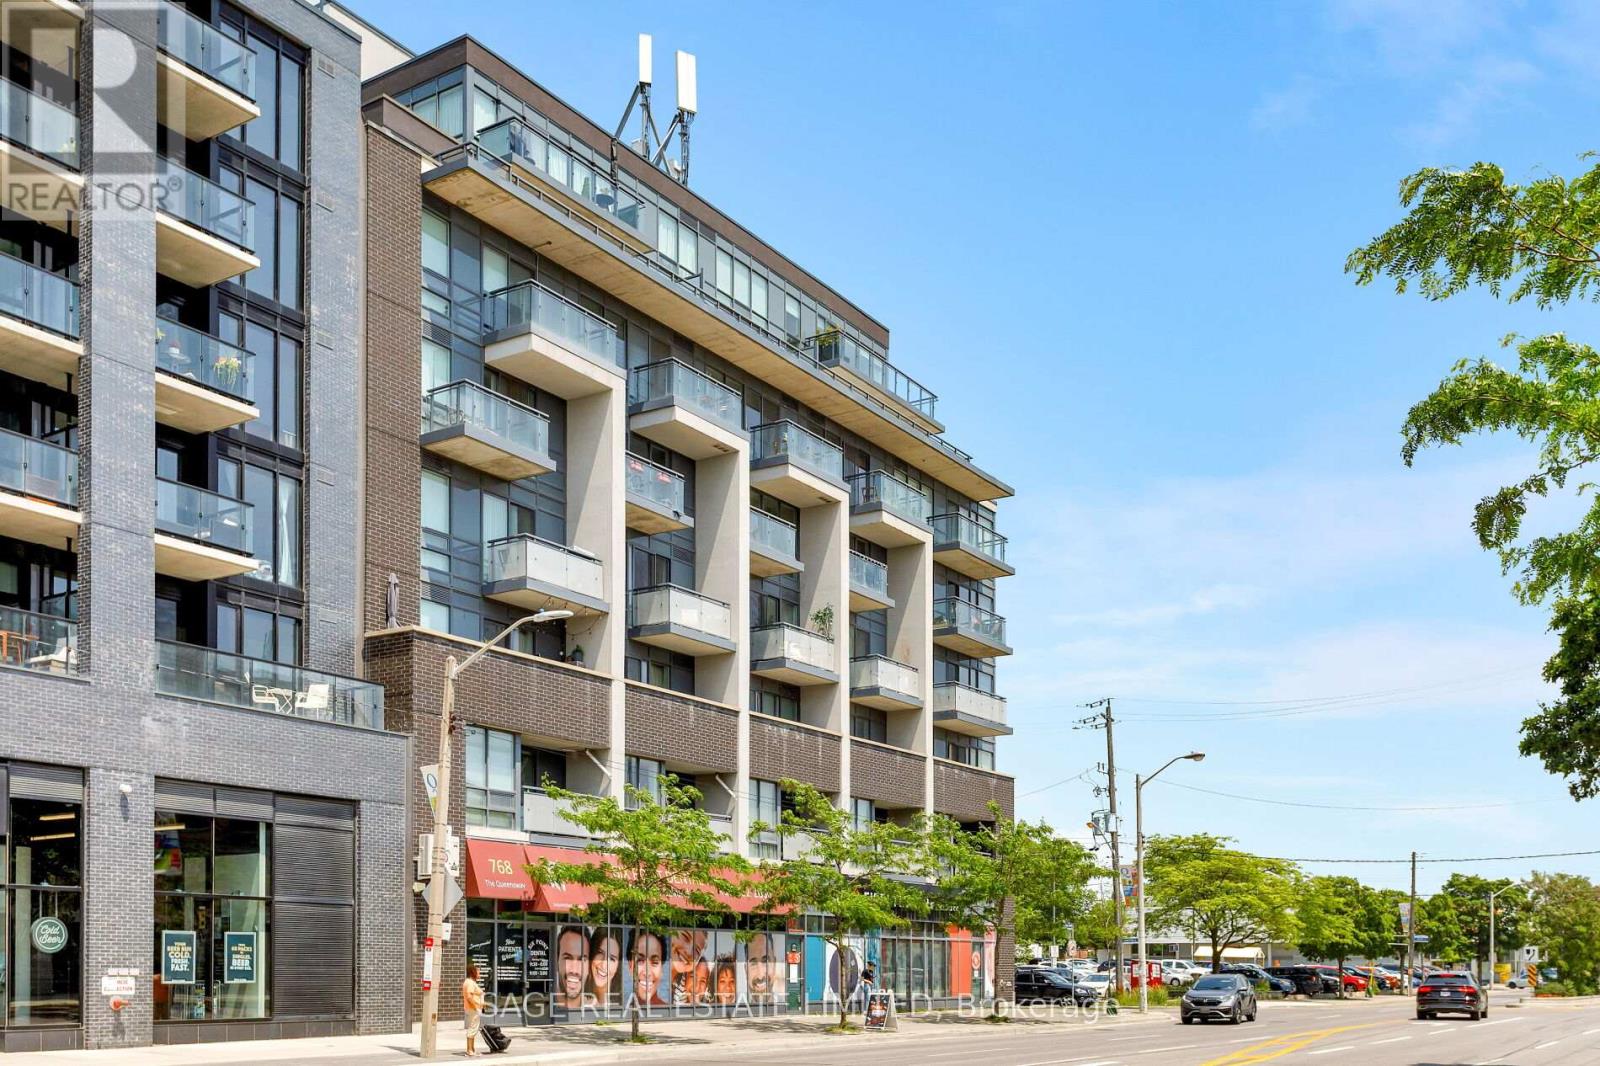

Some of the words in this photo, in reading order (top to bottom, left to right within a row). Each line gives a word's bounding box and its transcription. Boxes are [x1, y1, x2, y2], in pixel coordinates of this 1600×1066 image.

[488, 858, 513, 875] 768
[485, 879, 495, 888] The
[496, 880, 526, 889] Queensway
[40, 924, 60, 935] Cold
[39, 934, 61, 944] Beer
[168, 951, 192, 959] COLD.
[171, 964, 190, 972] FAST.
[231, 959, 250, 967] BEER
